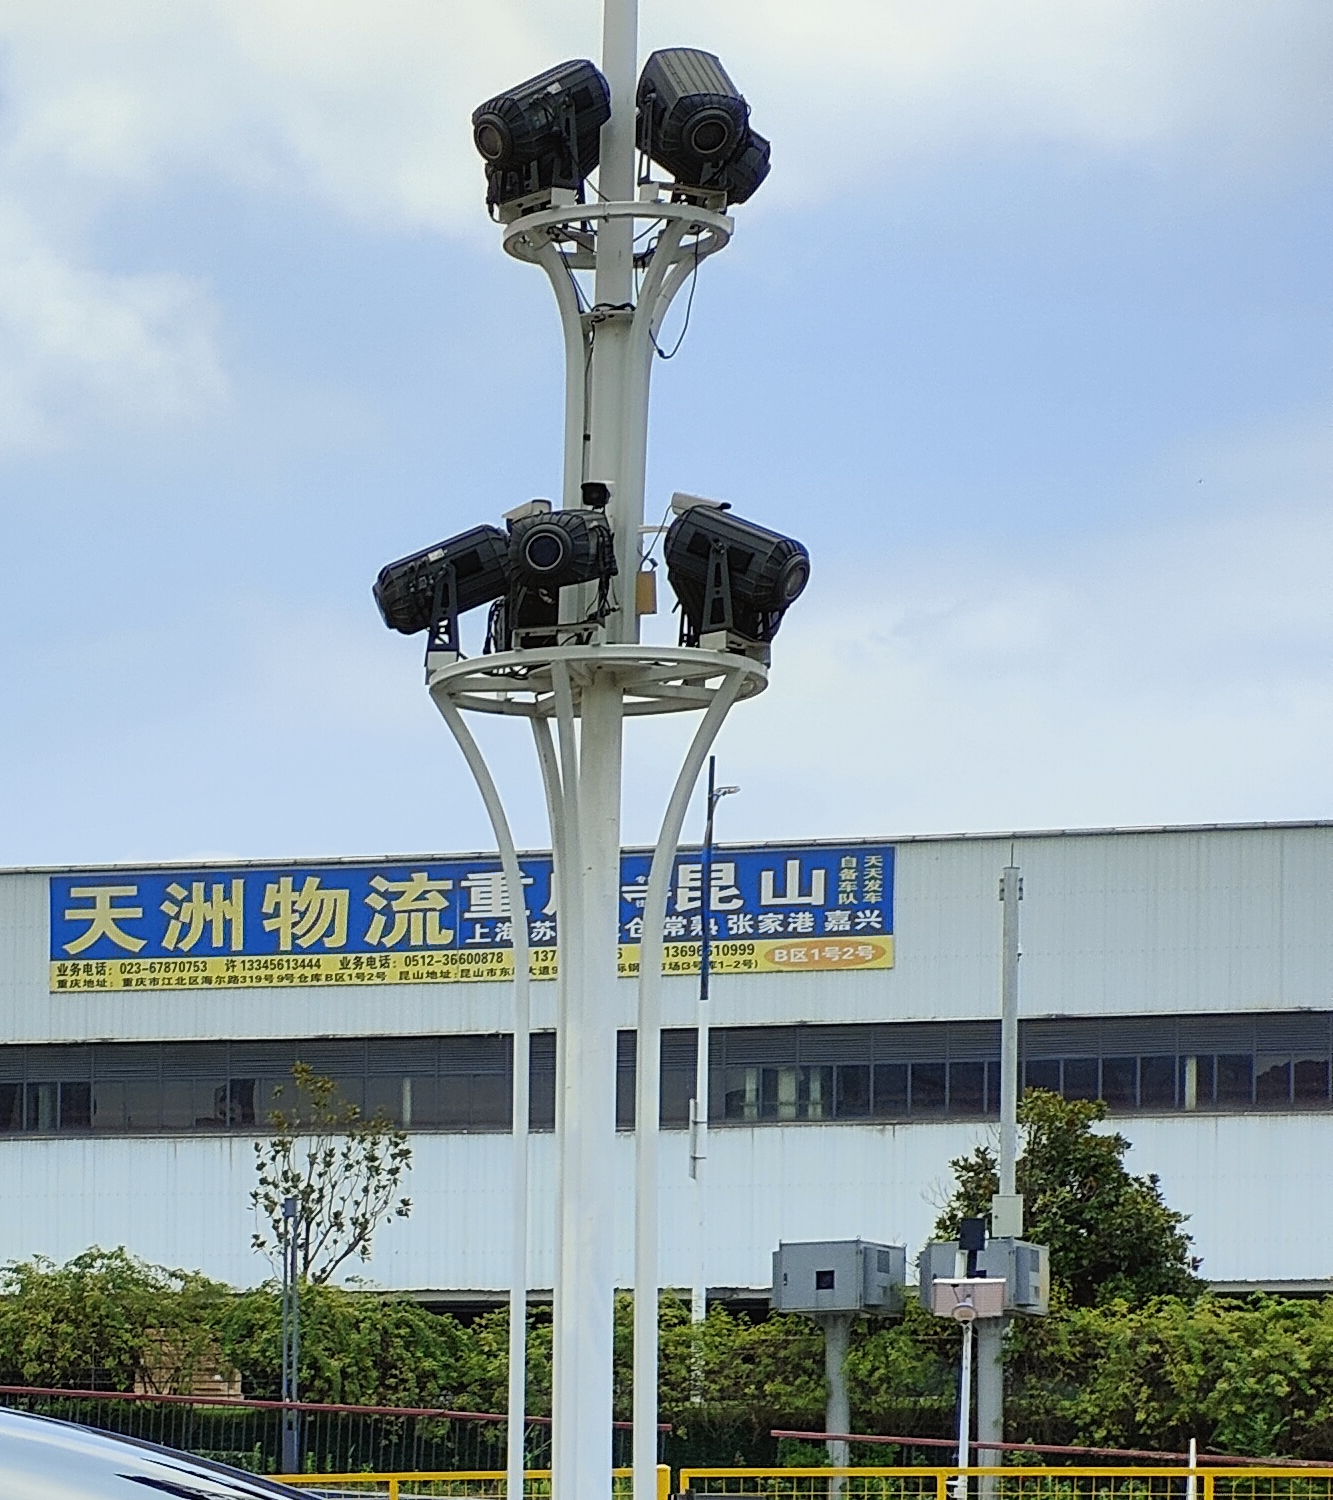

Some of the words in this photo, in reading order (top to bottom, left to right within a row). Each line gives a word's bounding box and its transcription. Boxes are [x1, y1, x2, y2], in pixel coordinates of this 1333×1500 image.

[838, 856, 858, 904] 自备车队
[863, 855, 883, 904] 天天发车
[62, 872, 454, 955] 天洲物流
[461, 870, 557, 919] 重
[675, 859, 826, 912] 昆山
[727, 912, 814, 934] 张家港
[824, 910, 882, 932] 嘉兴
[120, 961, 208, 975] 023-67870753
[241, 958, 321, 971] 13345613444
[404, 952, 504, 967] 0512-36600878
[775, 943, 876, 962] B区1号2号
